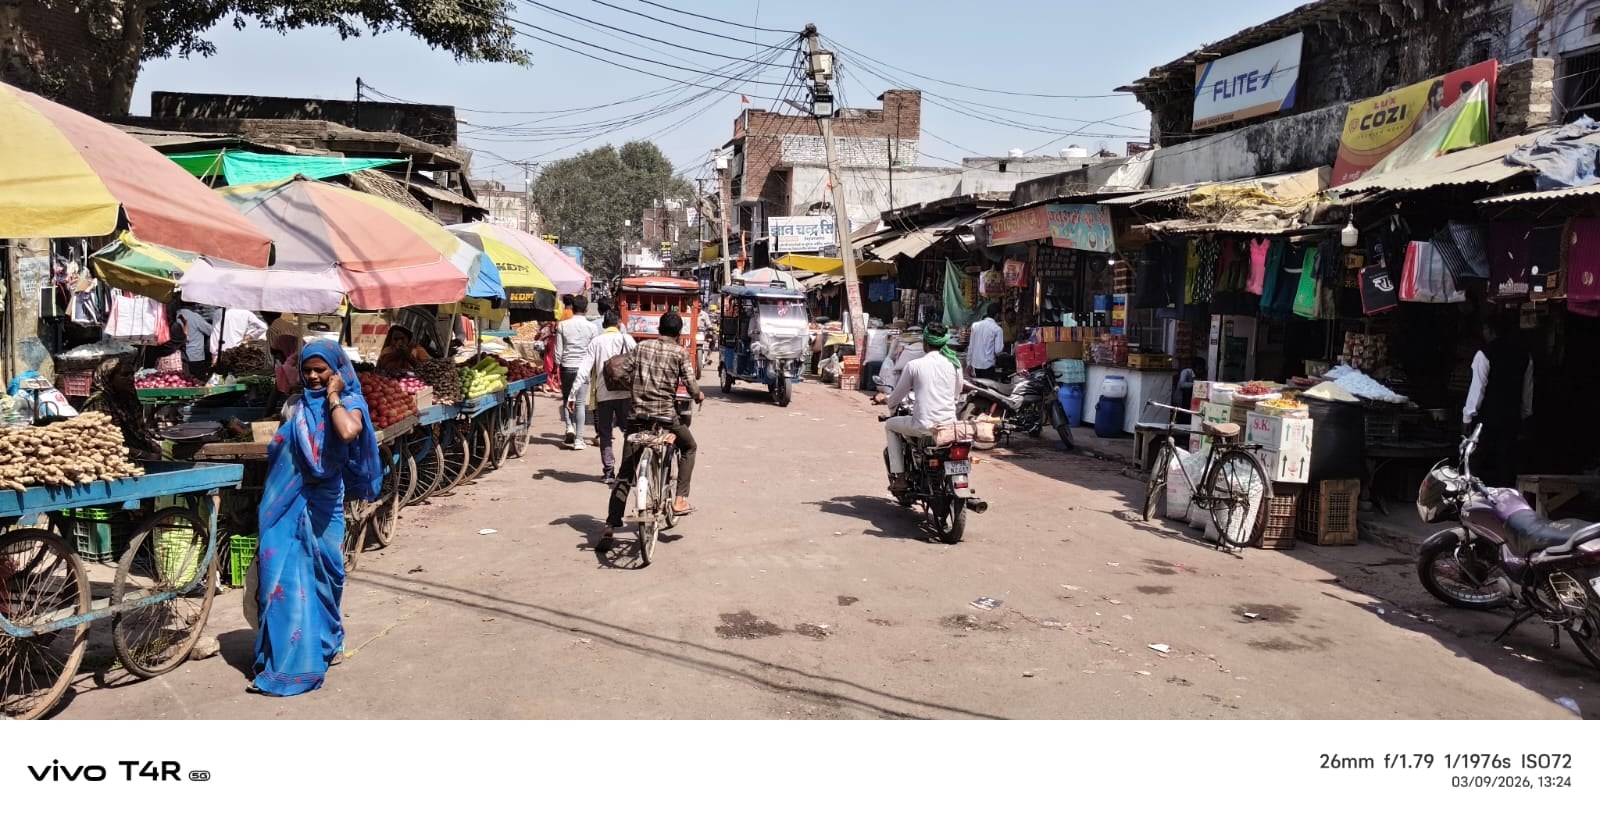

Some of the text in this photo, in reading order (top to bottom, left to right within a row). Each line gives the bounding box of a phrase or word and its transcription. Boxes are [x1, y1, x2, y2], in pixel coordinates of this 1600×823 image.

[1213, 69, 1259, 103] FLITE
[1374, 97, 1396, 110] LUX
[1360, 104, 1407, 131] COZI
[510, 291, 535, 302] KDM
[1253, 419, 1270, 432] S.K.
